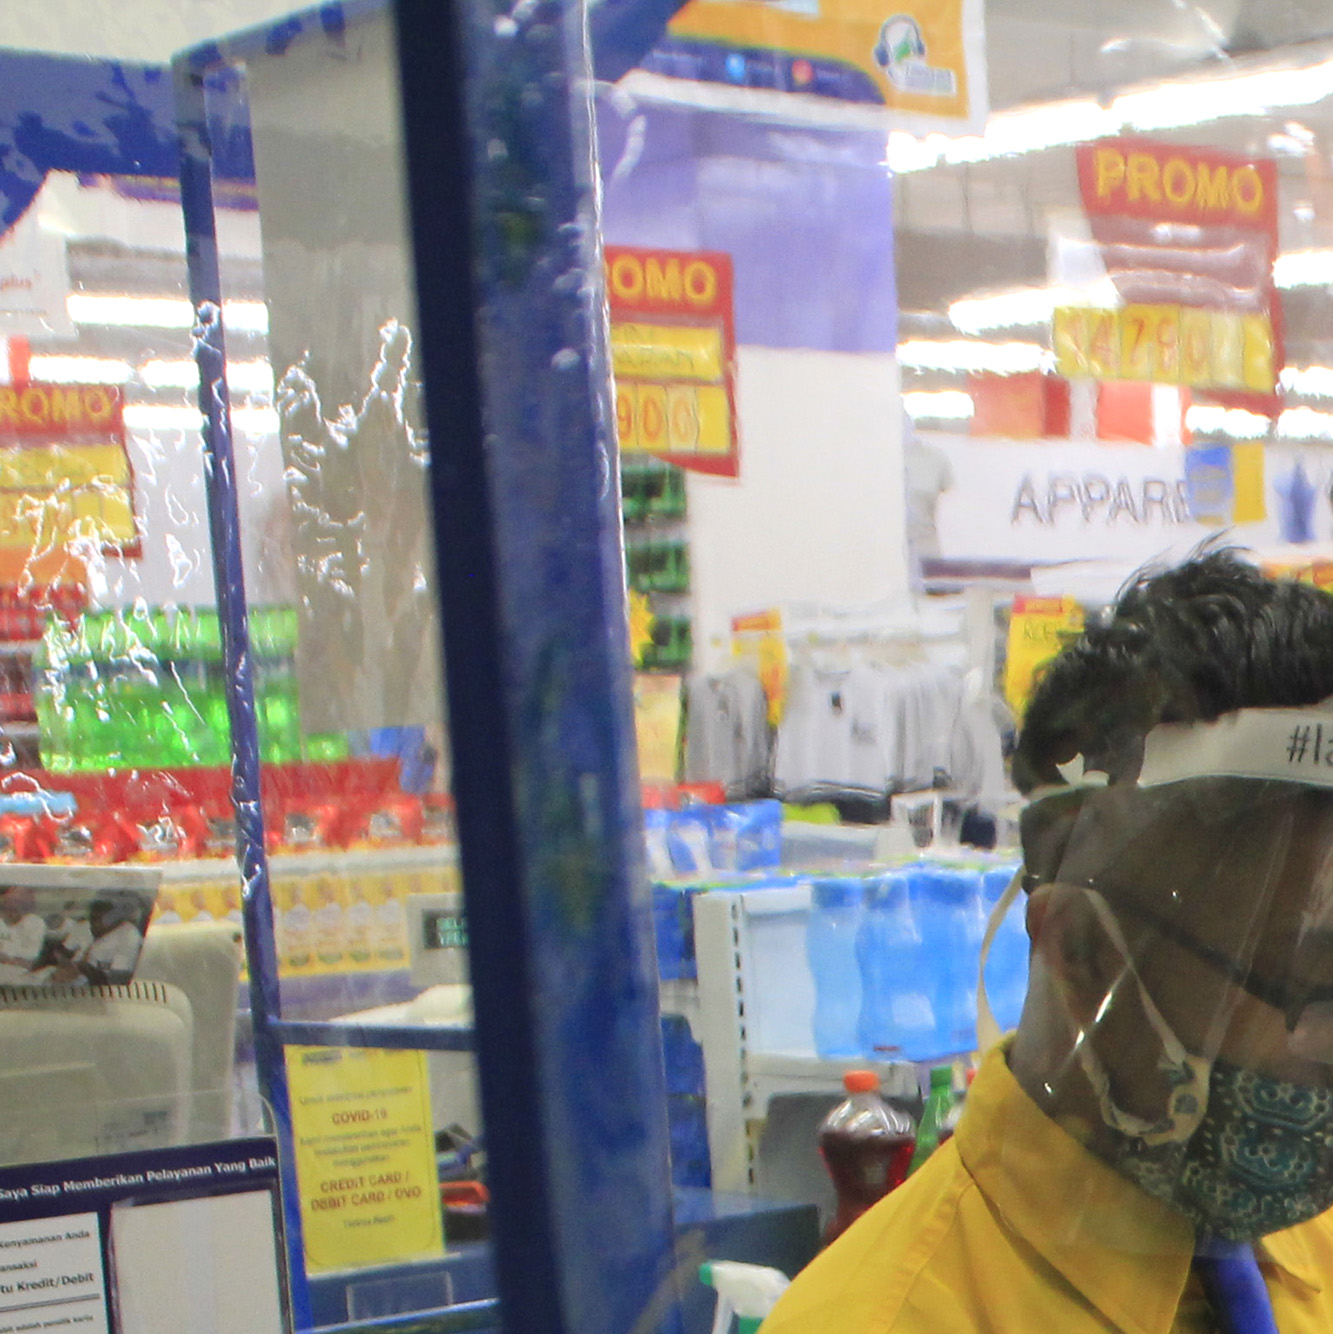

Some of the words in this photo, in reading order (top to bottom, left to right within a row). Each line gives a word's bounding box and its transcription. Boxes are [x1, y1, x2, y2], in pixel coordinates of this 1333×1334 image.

[1095, 148, 1263, 214] PROMO
[607, 254, 716, 306] OMO
[332, 1109, 387, 1125] COVID-19
[31, 1182, 61, 1197] Siap
[64, 1171, 144, 1192] Memberikan
[147, 1163, 212, 1184] Pelayanan
[214, 1159, 246, 1174] Yang
[249, 1155, 276, 1169] Baik
[320, 1176, 365, 1193] CREDIT
[369, 1172, 402, 1185] CARD
[311, 1196, 346, 1212] DEBIT
[351, 1191, 385, 1206] CARD
[395, 1186, 422, 1199] OVO
[17, 1272, 94, 1292] Kredit/Debit
